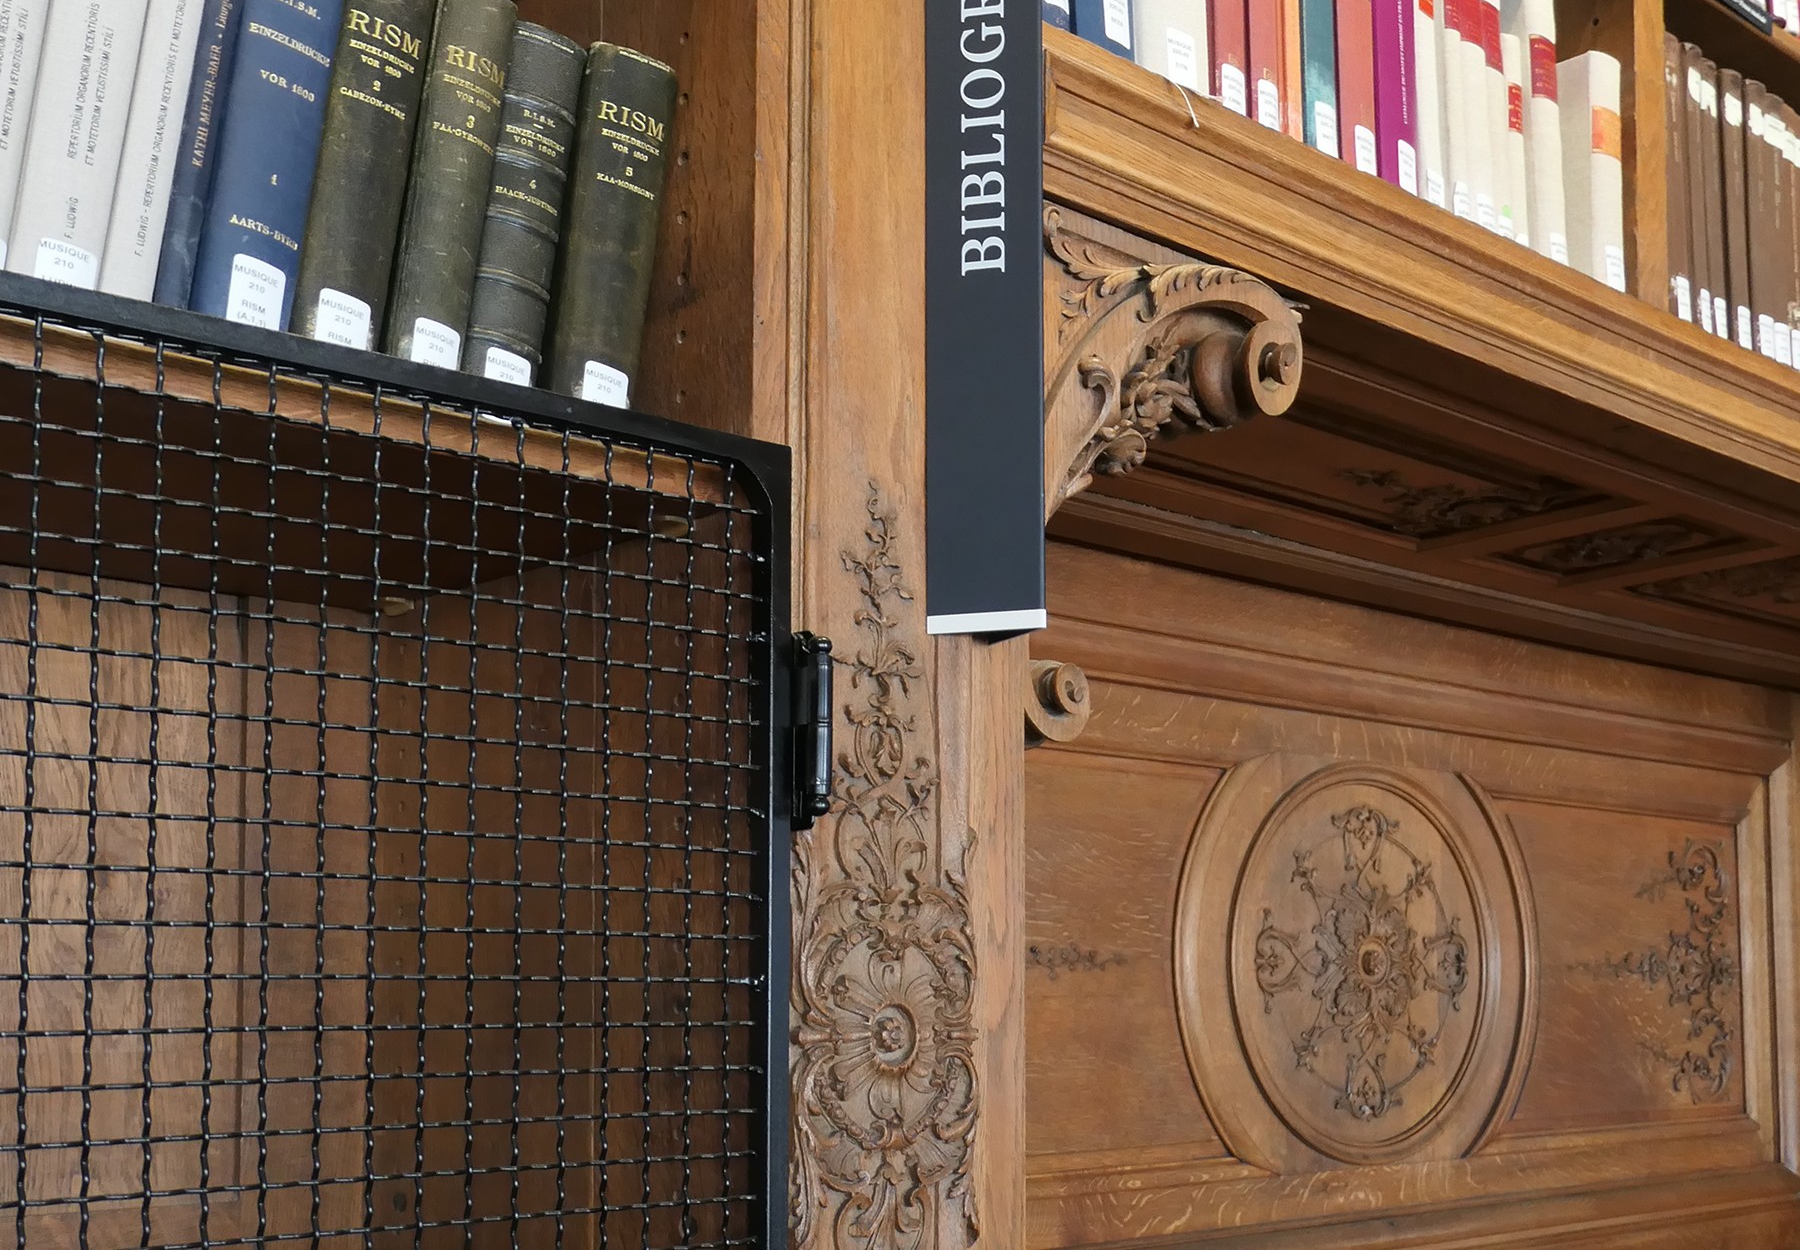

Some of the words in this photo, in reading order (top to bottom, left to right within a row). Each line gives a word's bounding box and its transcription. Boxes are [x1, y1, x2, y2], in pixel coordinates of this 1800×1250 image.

[17, 6, 30, 31] STILI
[83, 2, 101, 57] RECENTIORIS
[102, 25, 115, 50] STILI
[249, 22, 331, 68] EINZELDRUCKE
[347, 8, 422, 61] RISM
[9, 31, 26, 87] VETUSTISSIMI
[168, 42, 179, 54] ET
[349, 38, 415, 75] EINZELDRUCKE
[76, 54, 92, 104] ORGANORUM
[161, 53, 178, 105] RECENTIORIS
[361, 54, 381, 69] VOR
[384, 65, 402, 79] 1800
[446, 44, 505, 90] RISM
[94, 51, 111, 109] VETUSTISSIMI
[200, 45, 222, 126] MEYER-BAER
[260, 69, 289, 89] VOR
[291, 83, 315, 102] 1800
[372, 80, 382, 92] 2
[456, 90, 475, 104] VOR
[1, 87, 16, 139] MOTETORUM
[465, 114, 476, 129] 3
[523, 109, 556, 128] R.I.S.M.
[597, 100, 664, 142] RISM
[66, 103, 84, 160] REPERTORIUM
[86, 104, 102, 157] MOTETORUM
[152, 104, 169, 154] ORGANORUM
[601, 127, 660, 156] EINZELDRUCKE
[192, 126, 209, 168] KATHI
[513, 135, 534, 148] VOR
[538, 144, 557, 158] 1800
[612, 142, 629, 155] VOR
[633, 147, 649, 162] 1800
[84, 155, 94, 167] ET
[142, 153, 160, 208] REPERTORIUM
[270, 174, 278, 186] 1
[529, 179, 537, 190] 4
[596, 172, 655, 201] KAA-MONSIGNY
[65, 196, 79, 230] LUDWIG
[135, 214, 150, 248] LUDWIG
[40, 240, 90, 263] MUSIQUE
[54, 257, 75, 269] 210
[234, 264, 280, 289] MUSIQUE
[248, 281, 266, 294] 210
[241, 299, 266, 315] RISM
[321, 297, 365, 321] MUSIQUE
[334, 314, 352, 326] 210
[327, 331, 352, 345] RISM
[415, 325, 455, 348] MUSIQUE
[428, 342, 445, 355] 210
[487, 355, 525, 376] MUSIQUE
[499, 371, 515, 382] 210
[586, 368, 624, 389] MUSIQUE
[597, 383, 612, 394] 210
